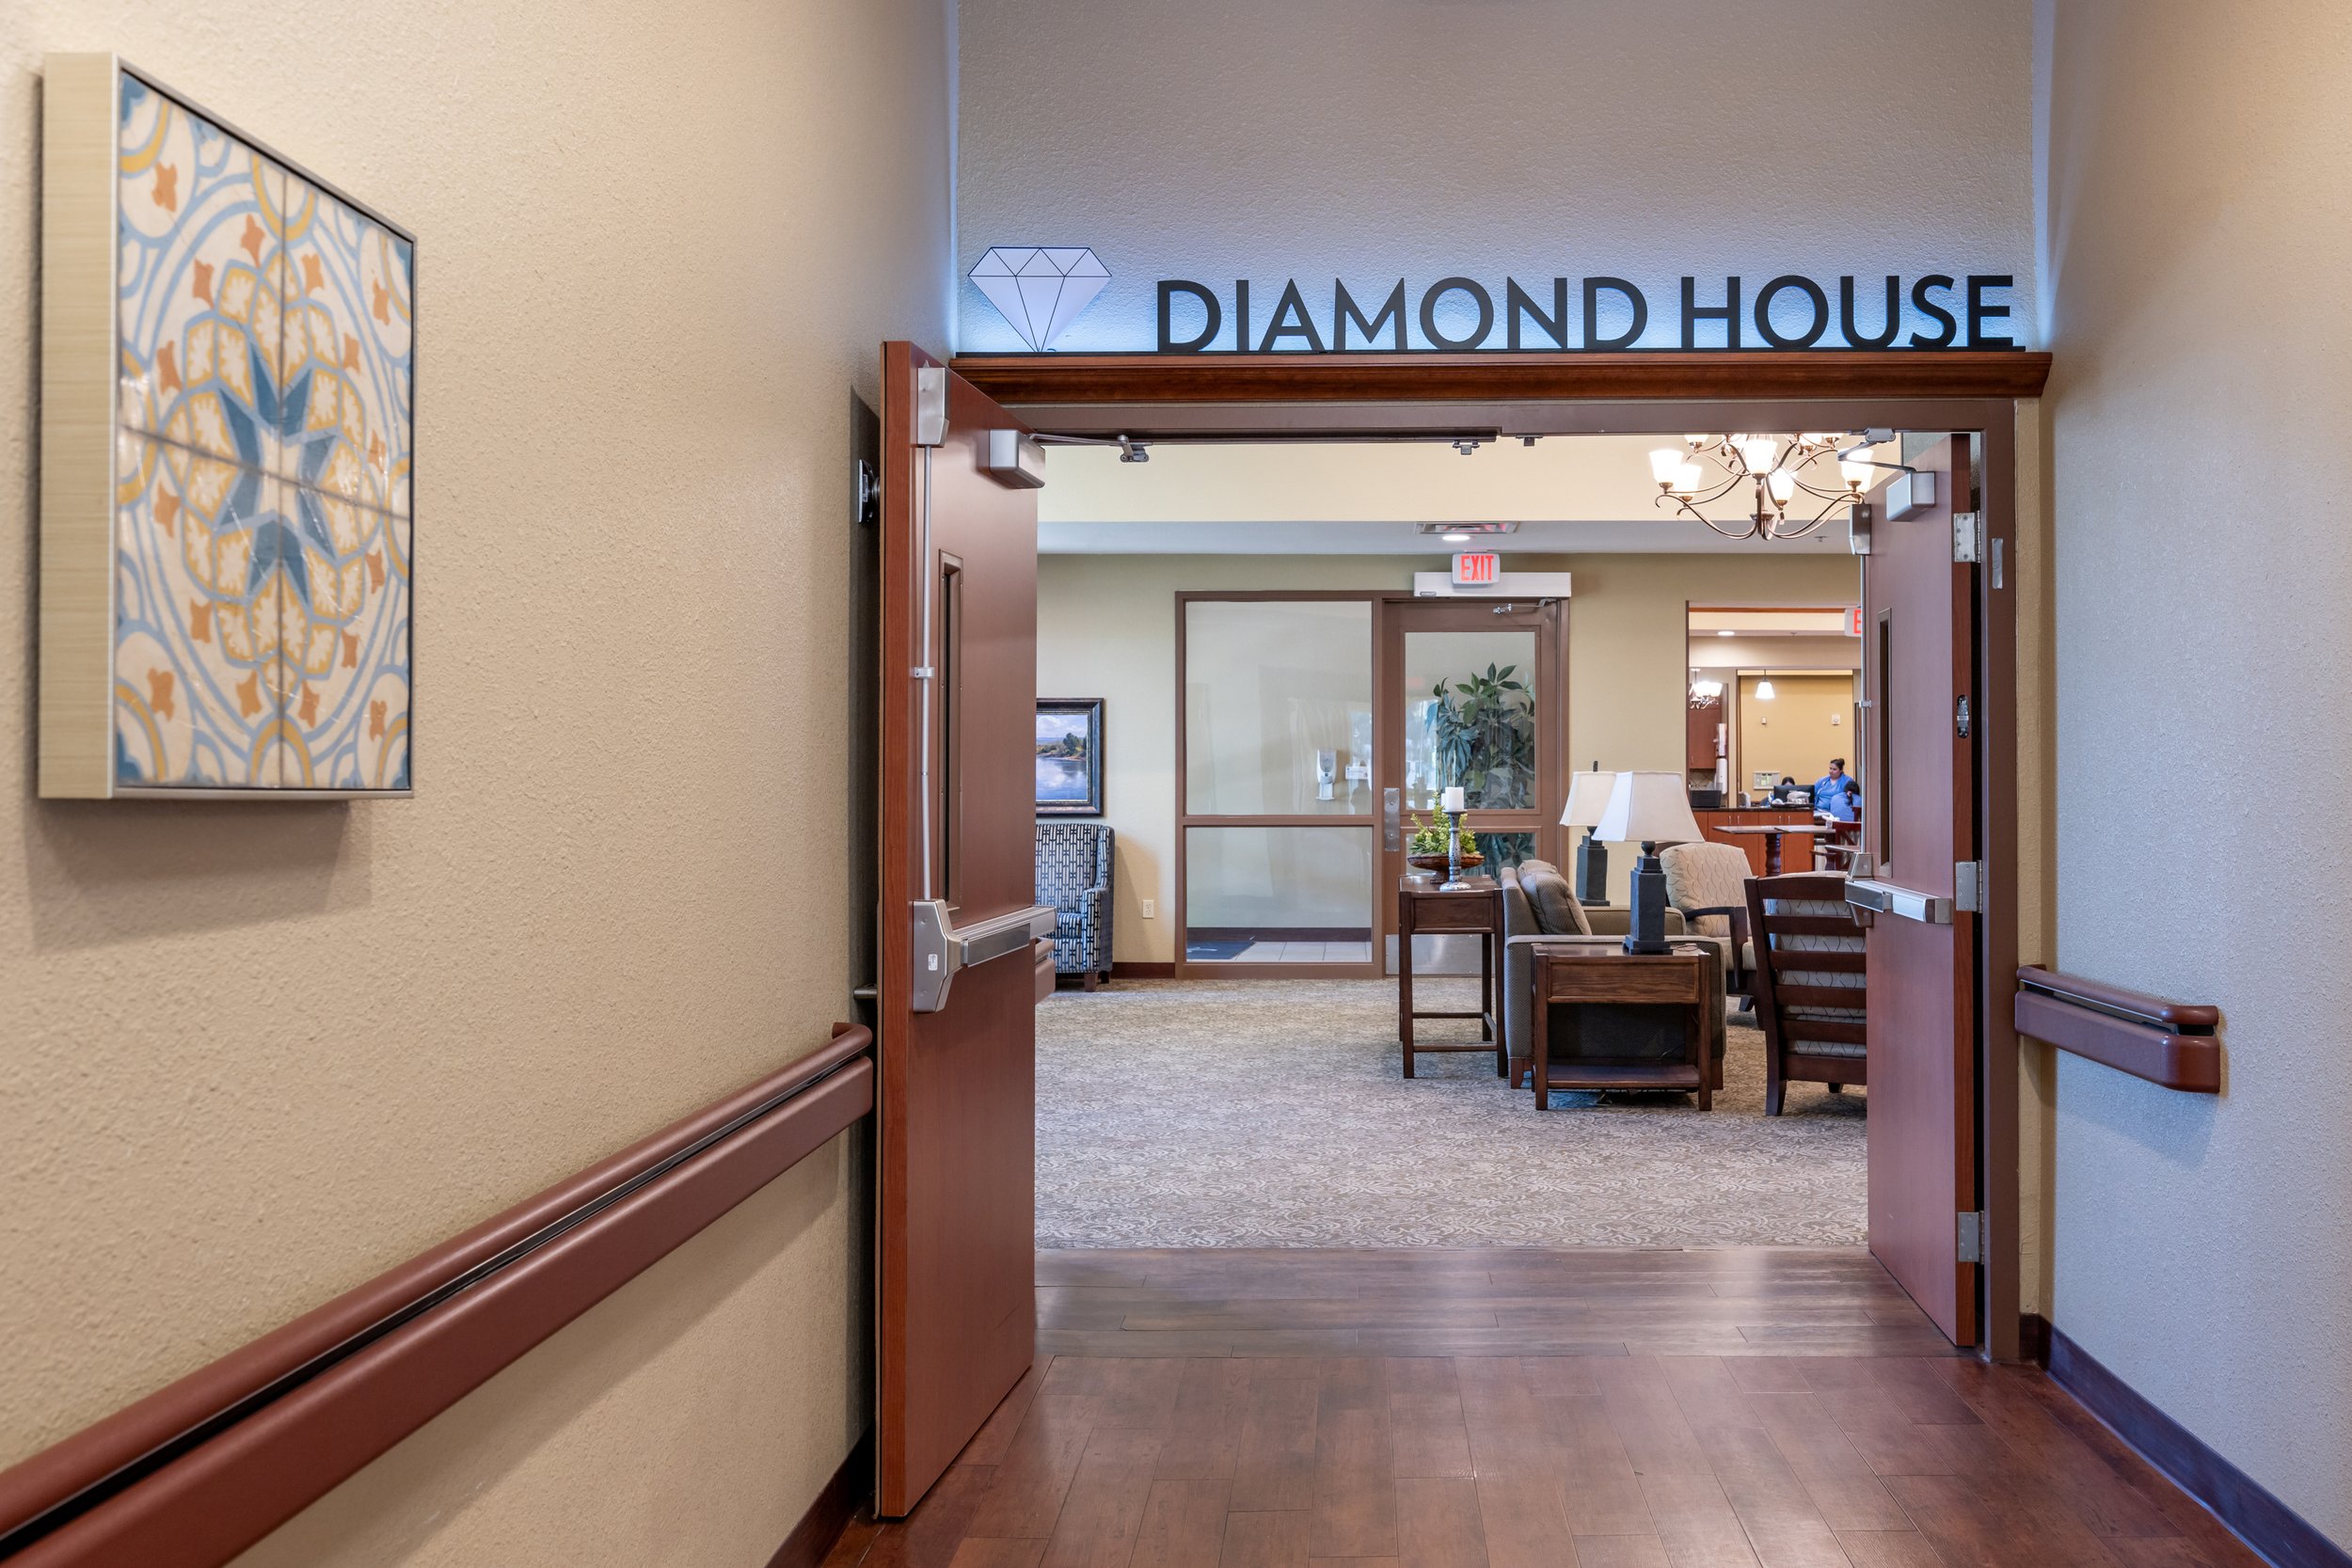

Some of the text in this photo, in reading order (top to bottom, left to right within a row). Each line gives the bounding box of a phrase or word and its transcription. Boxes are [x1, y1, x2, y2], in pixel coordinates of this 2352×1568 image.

[1157, 274, 2014, 352] DIAMOND HOUSE
[1460, 555, 1494, 581] EXIT
